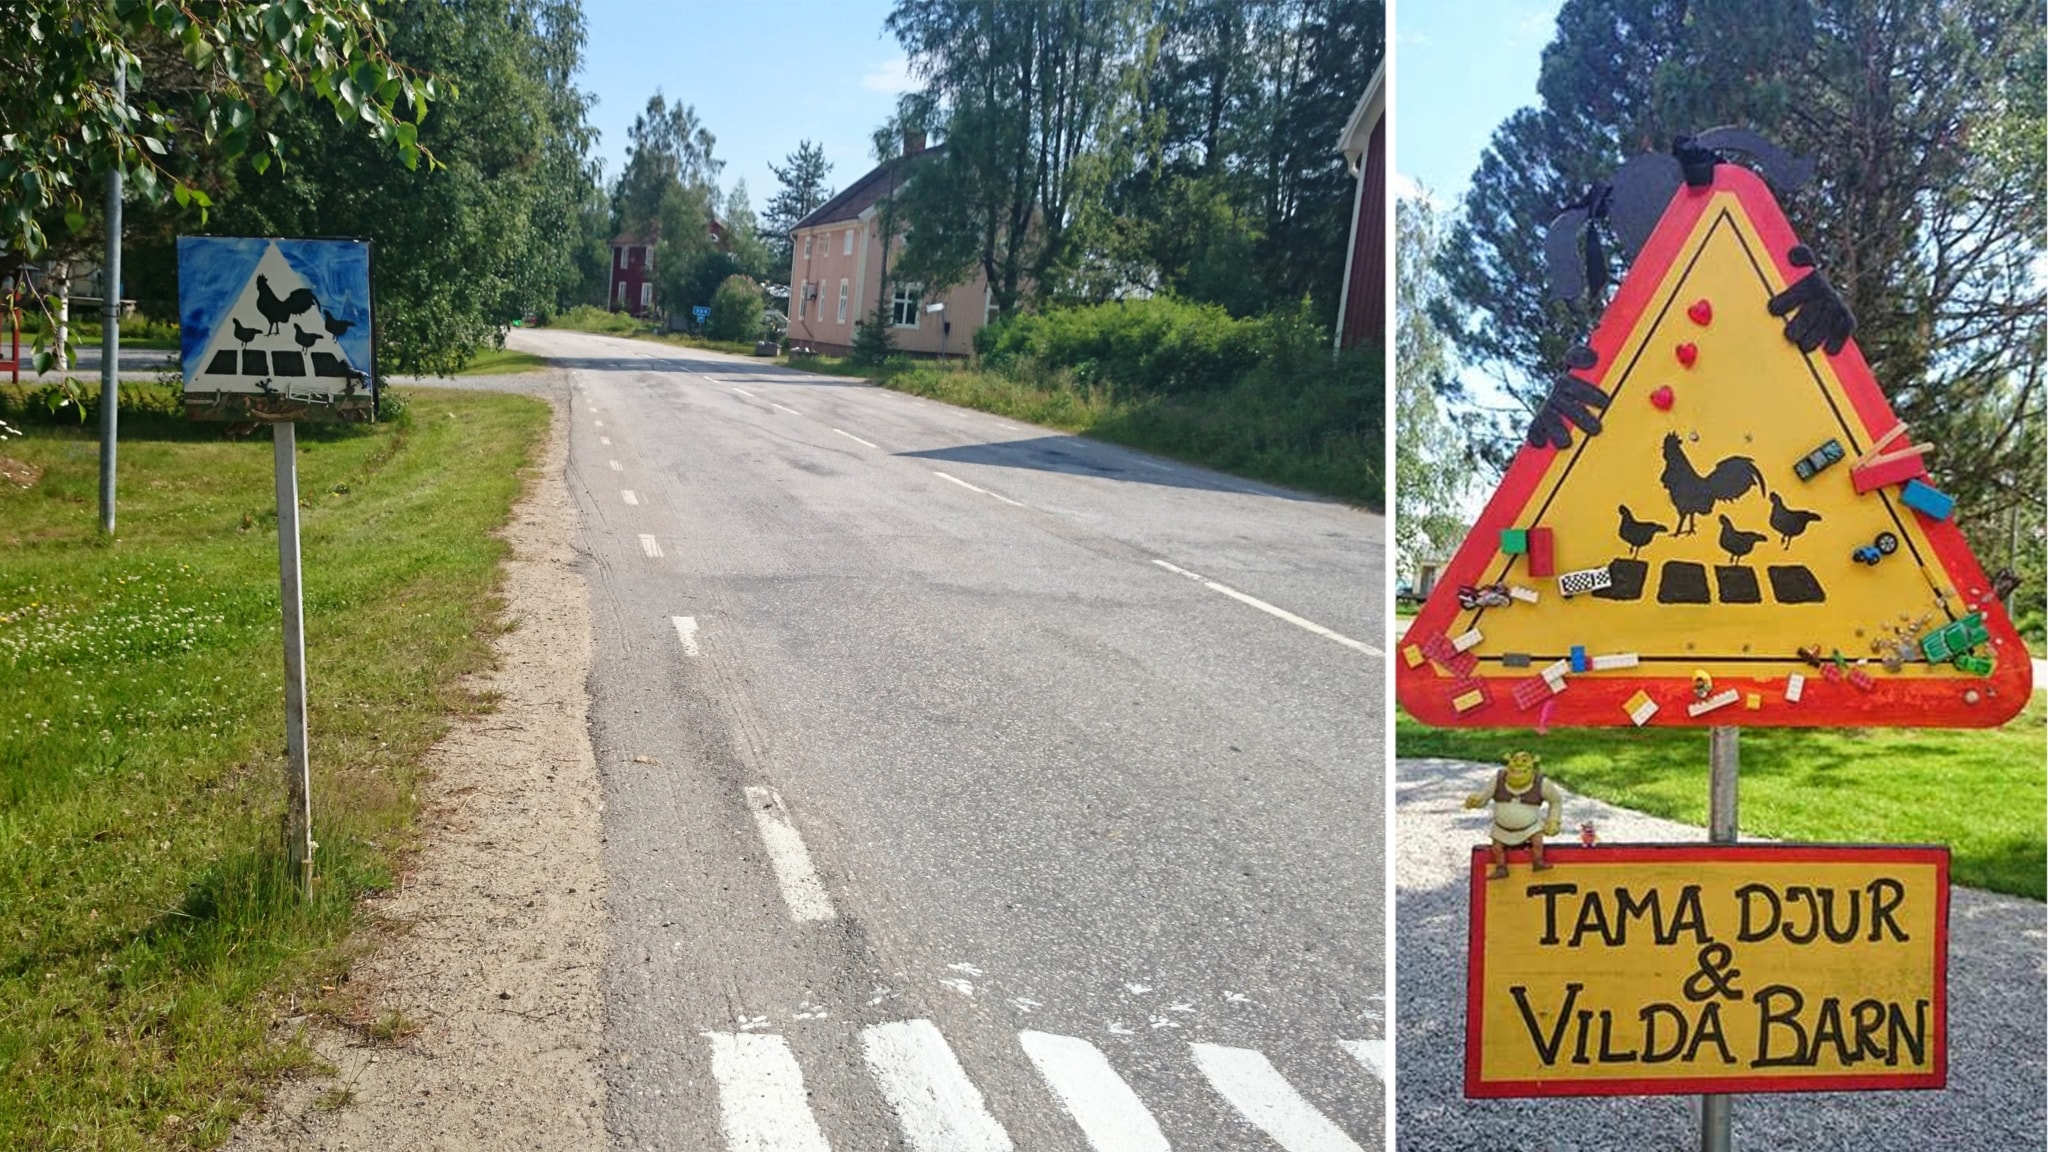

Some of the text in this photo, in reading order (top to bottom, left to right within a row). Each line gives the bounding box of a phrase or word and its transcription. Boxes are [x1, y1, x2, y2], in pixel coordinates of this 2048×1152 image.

[1527, 878, 1910, 946] TAMA DJUR
[1684, 942, 1744, 1002] &
[1510, 983, 1930, 1068] VILDA BARN
